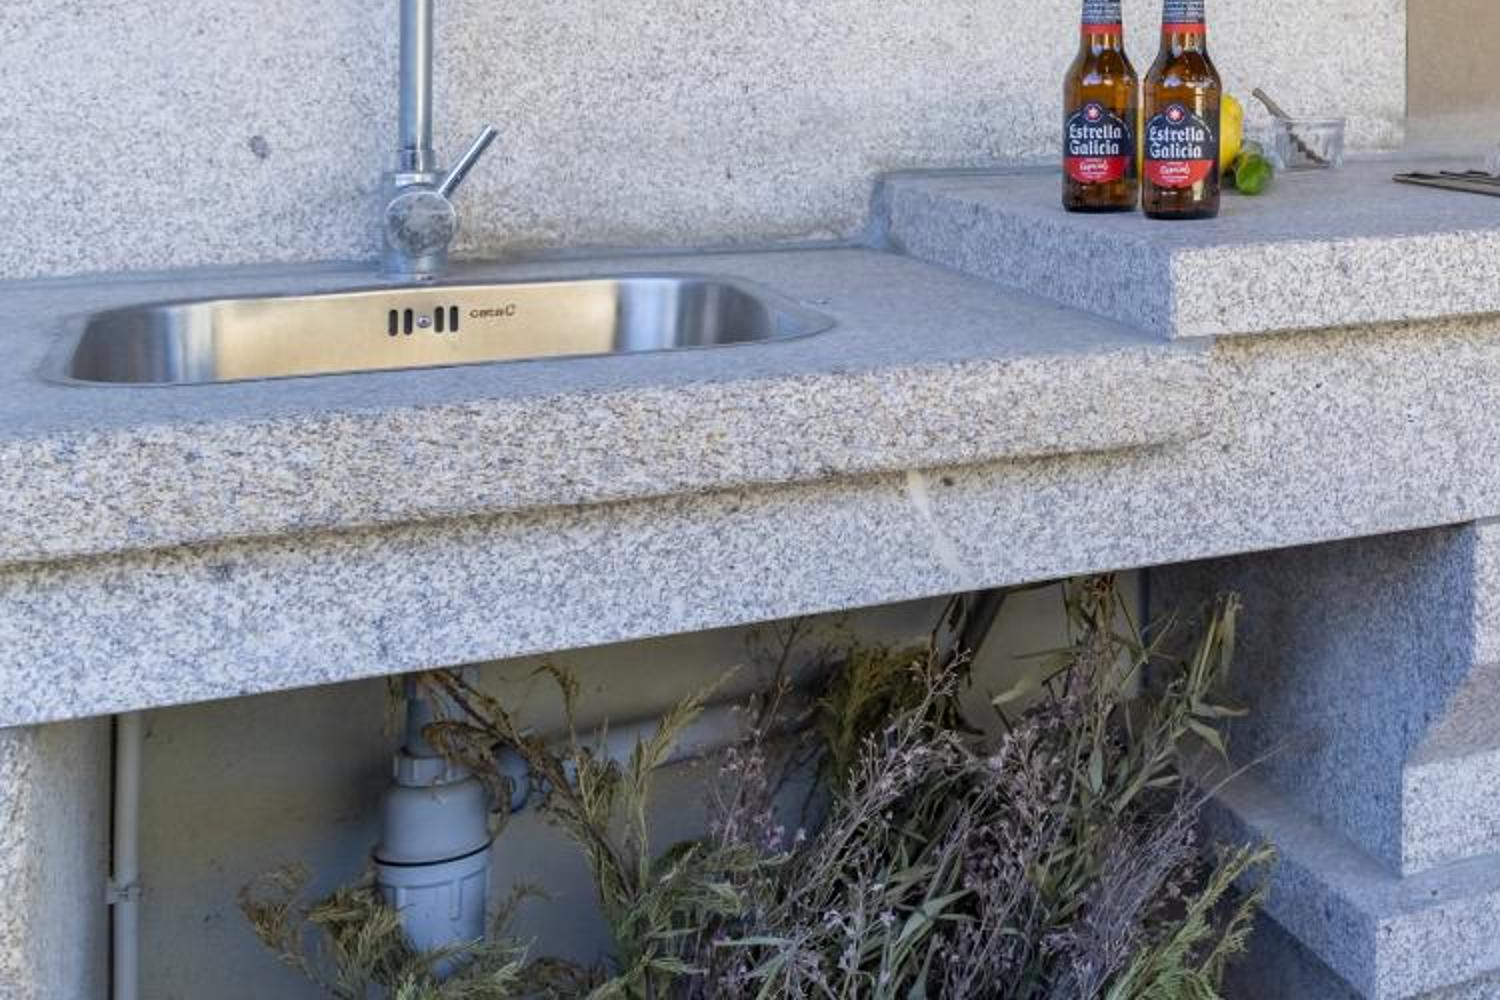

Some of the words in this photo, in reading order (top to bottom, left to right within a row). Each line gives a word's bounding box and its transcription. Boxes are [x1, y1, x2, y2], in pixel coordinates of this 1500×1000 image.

[1069, 123, 1121, 139] Estrella
[1149, 126, 1205, 142] Estrella
[1069, 139, 1119, 155] Galicia
[1149, 141, 1202, 159] Galicia
